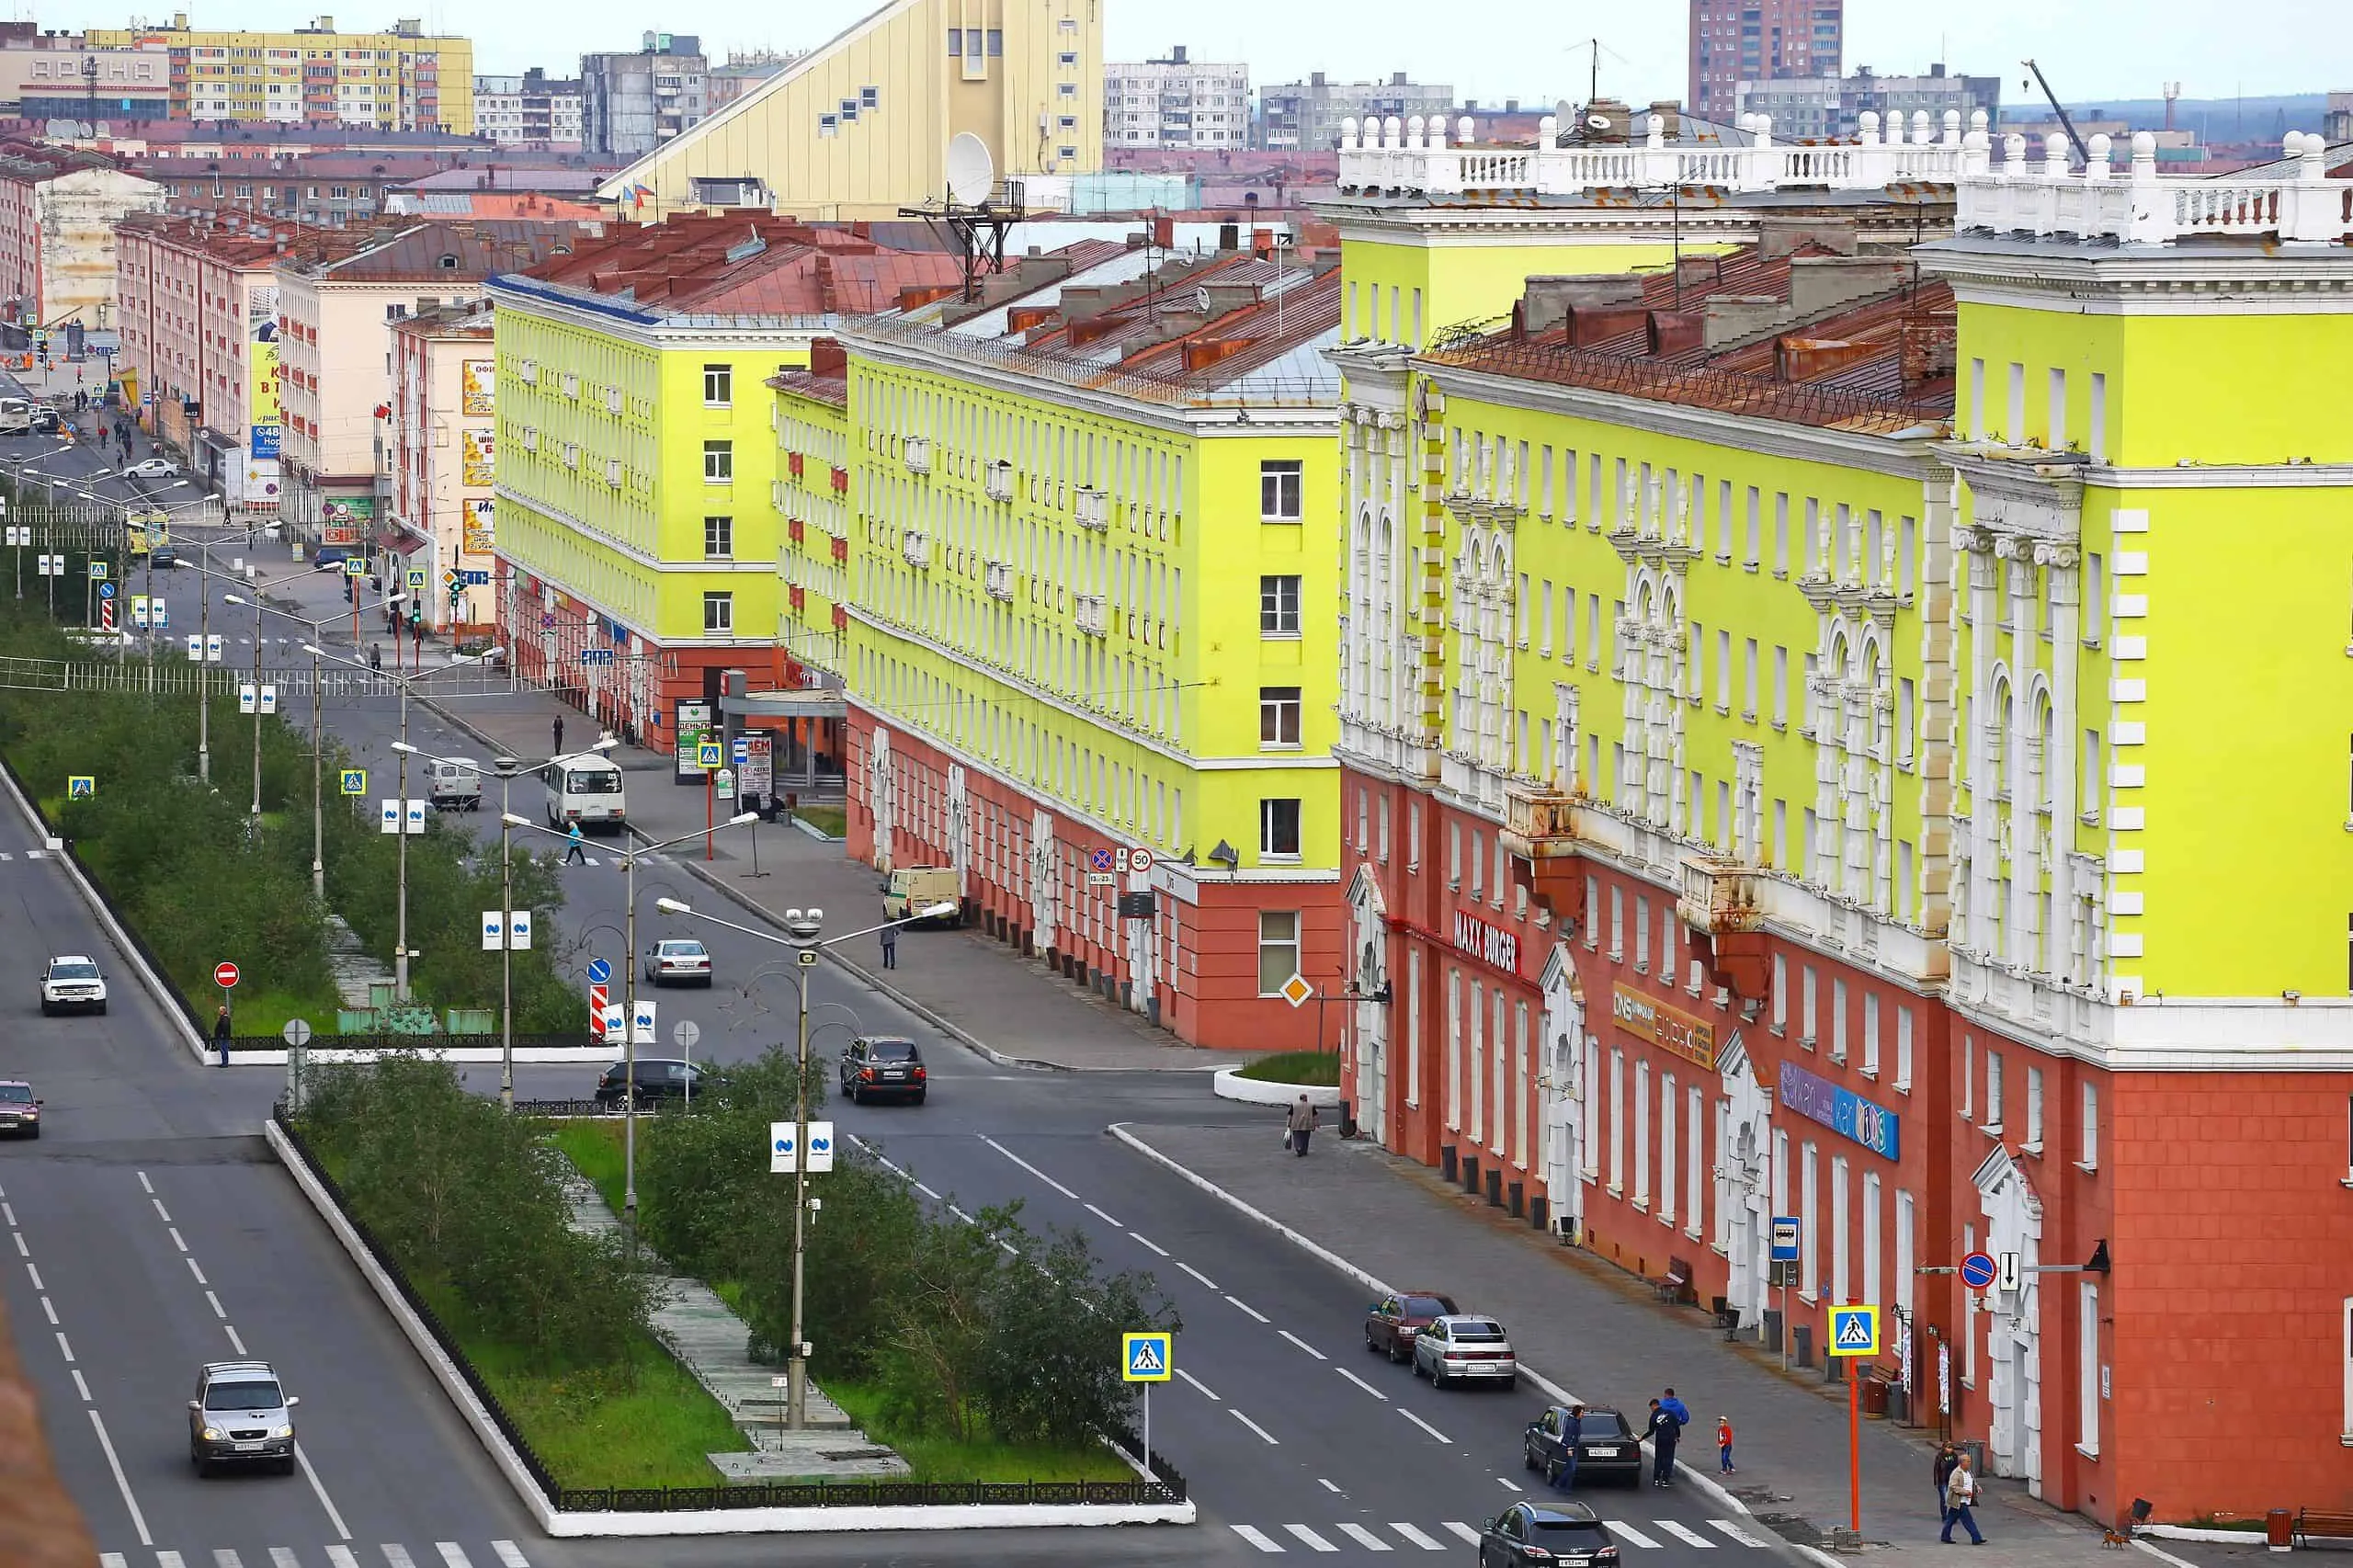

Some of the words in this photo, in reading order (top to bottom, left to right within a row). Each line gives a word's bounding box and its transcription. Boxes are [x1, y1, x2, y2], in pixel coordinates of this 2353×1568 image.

[1134, 855, 1149, 865] 50
[1454, 910, 1482, 958] MAXX
[1483, 923, 1517, 974] BURGER
[1614, 991, 1632, 1022] DNS
